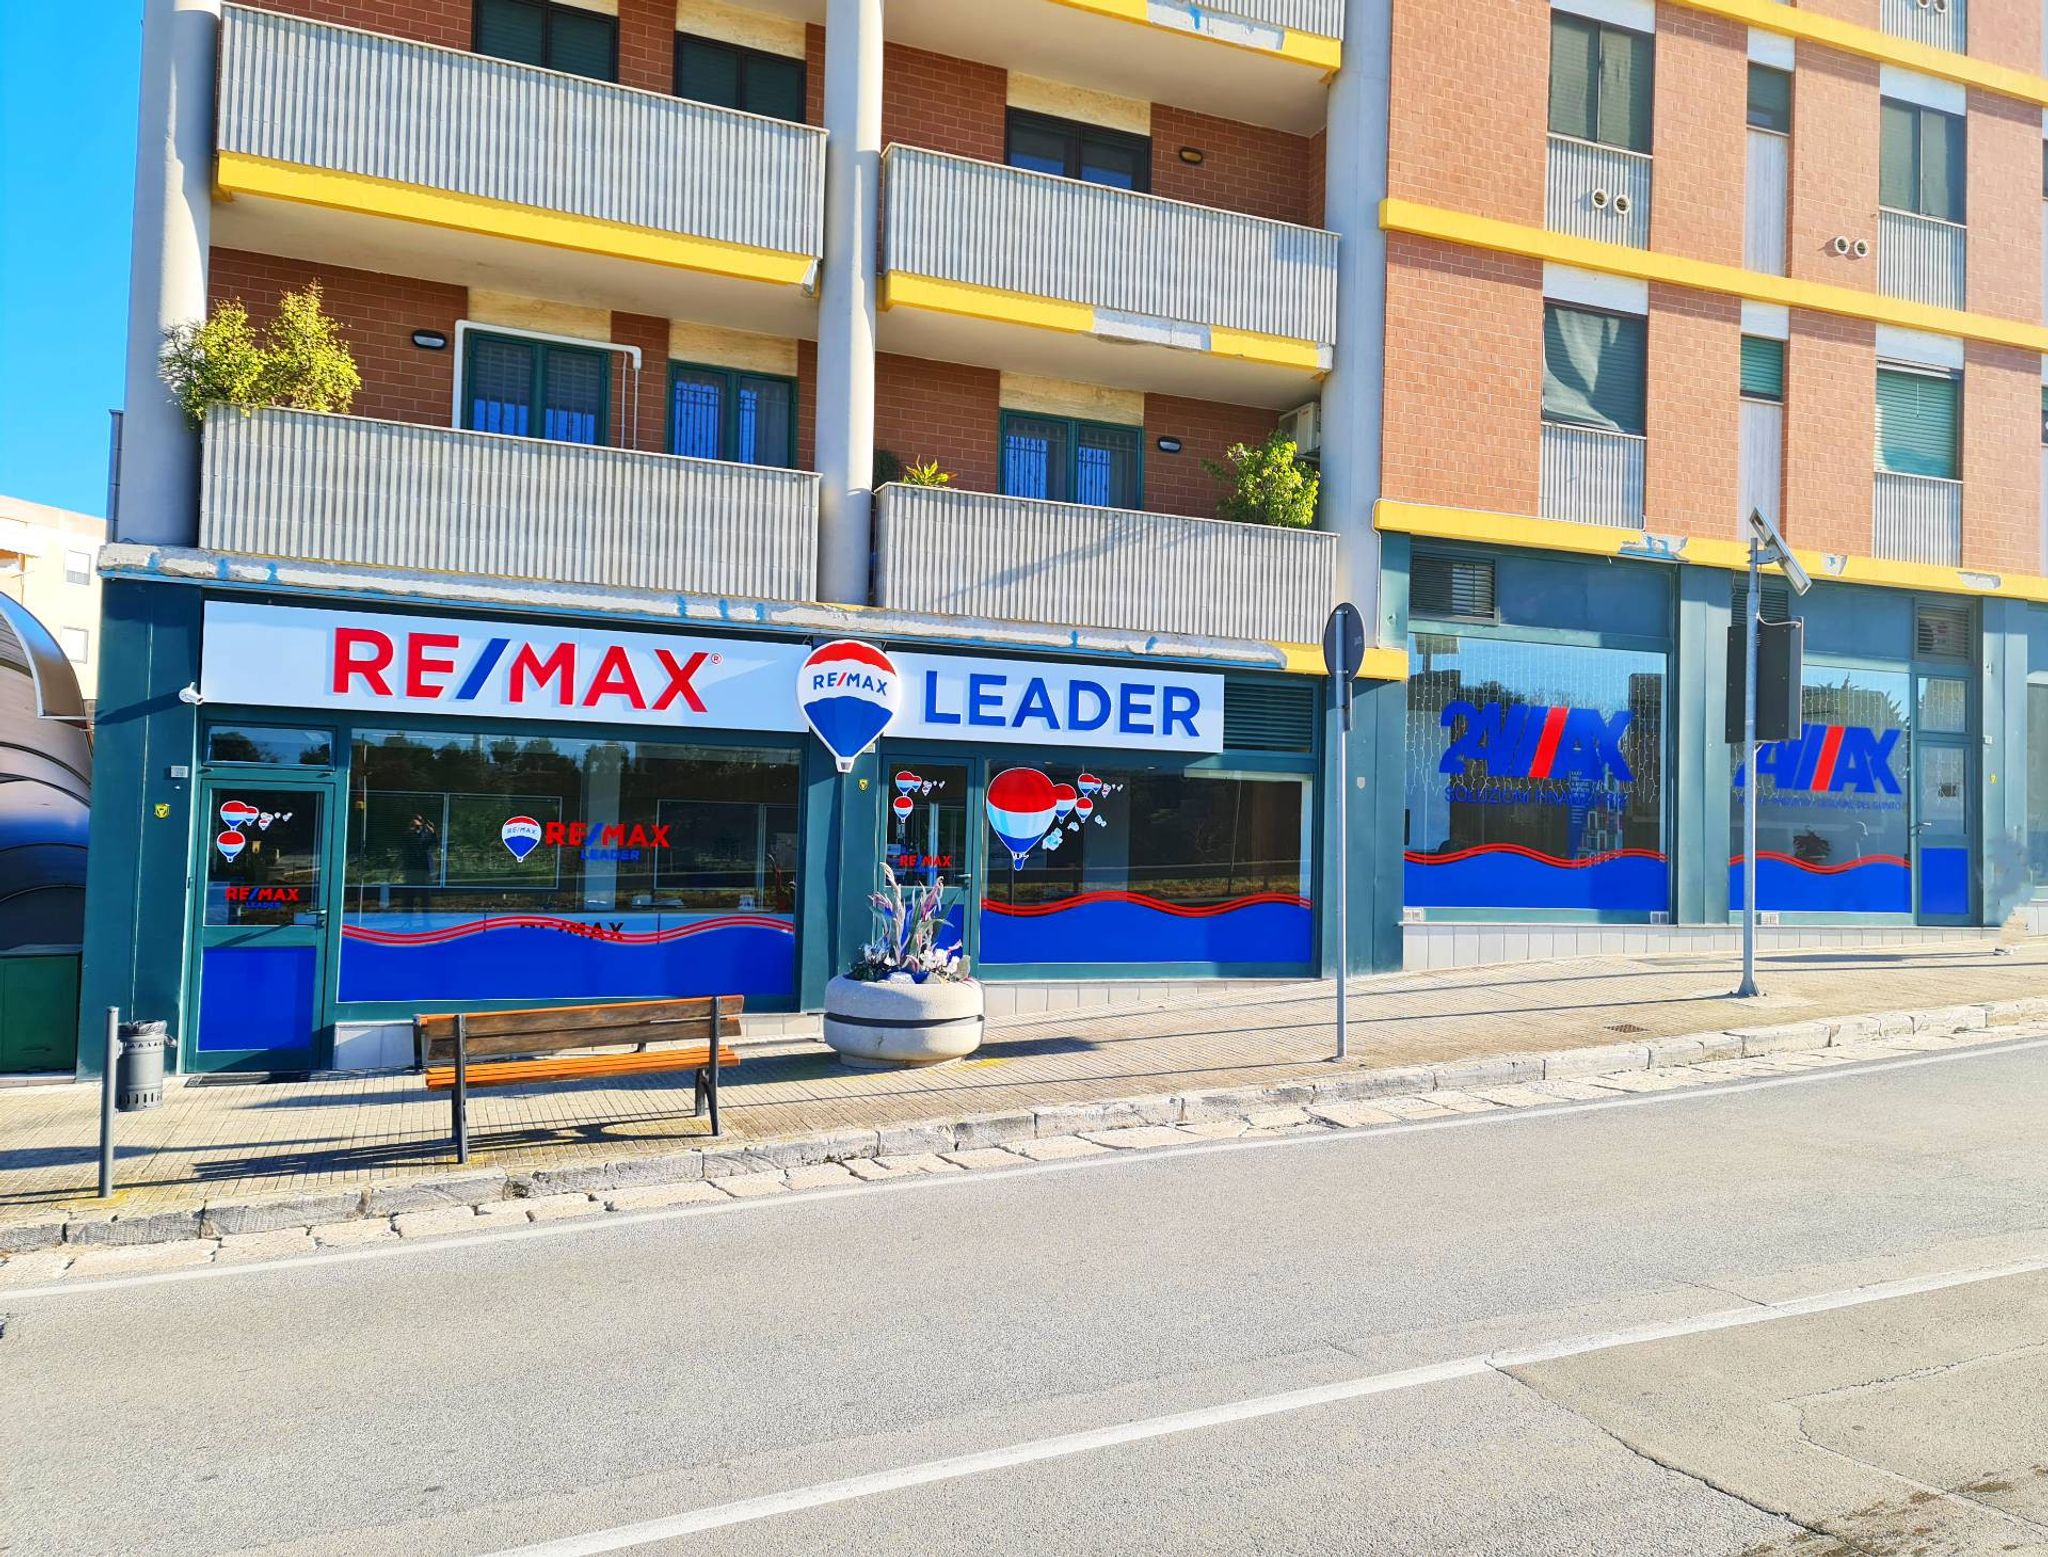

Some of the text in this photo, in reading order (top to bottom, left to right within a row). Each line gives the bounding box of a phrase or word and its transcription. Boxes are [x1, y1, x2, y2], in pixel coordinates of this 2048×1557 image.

[813, 671, 888, 696] RE/MAX
[923, 670, 1201, 738] LEADER
[545, 821, 671, 848] RE/MAX
[580, 849, 640, 860] LEADER
[225, 887, 299, 901] RE/MAX
